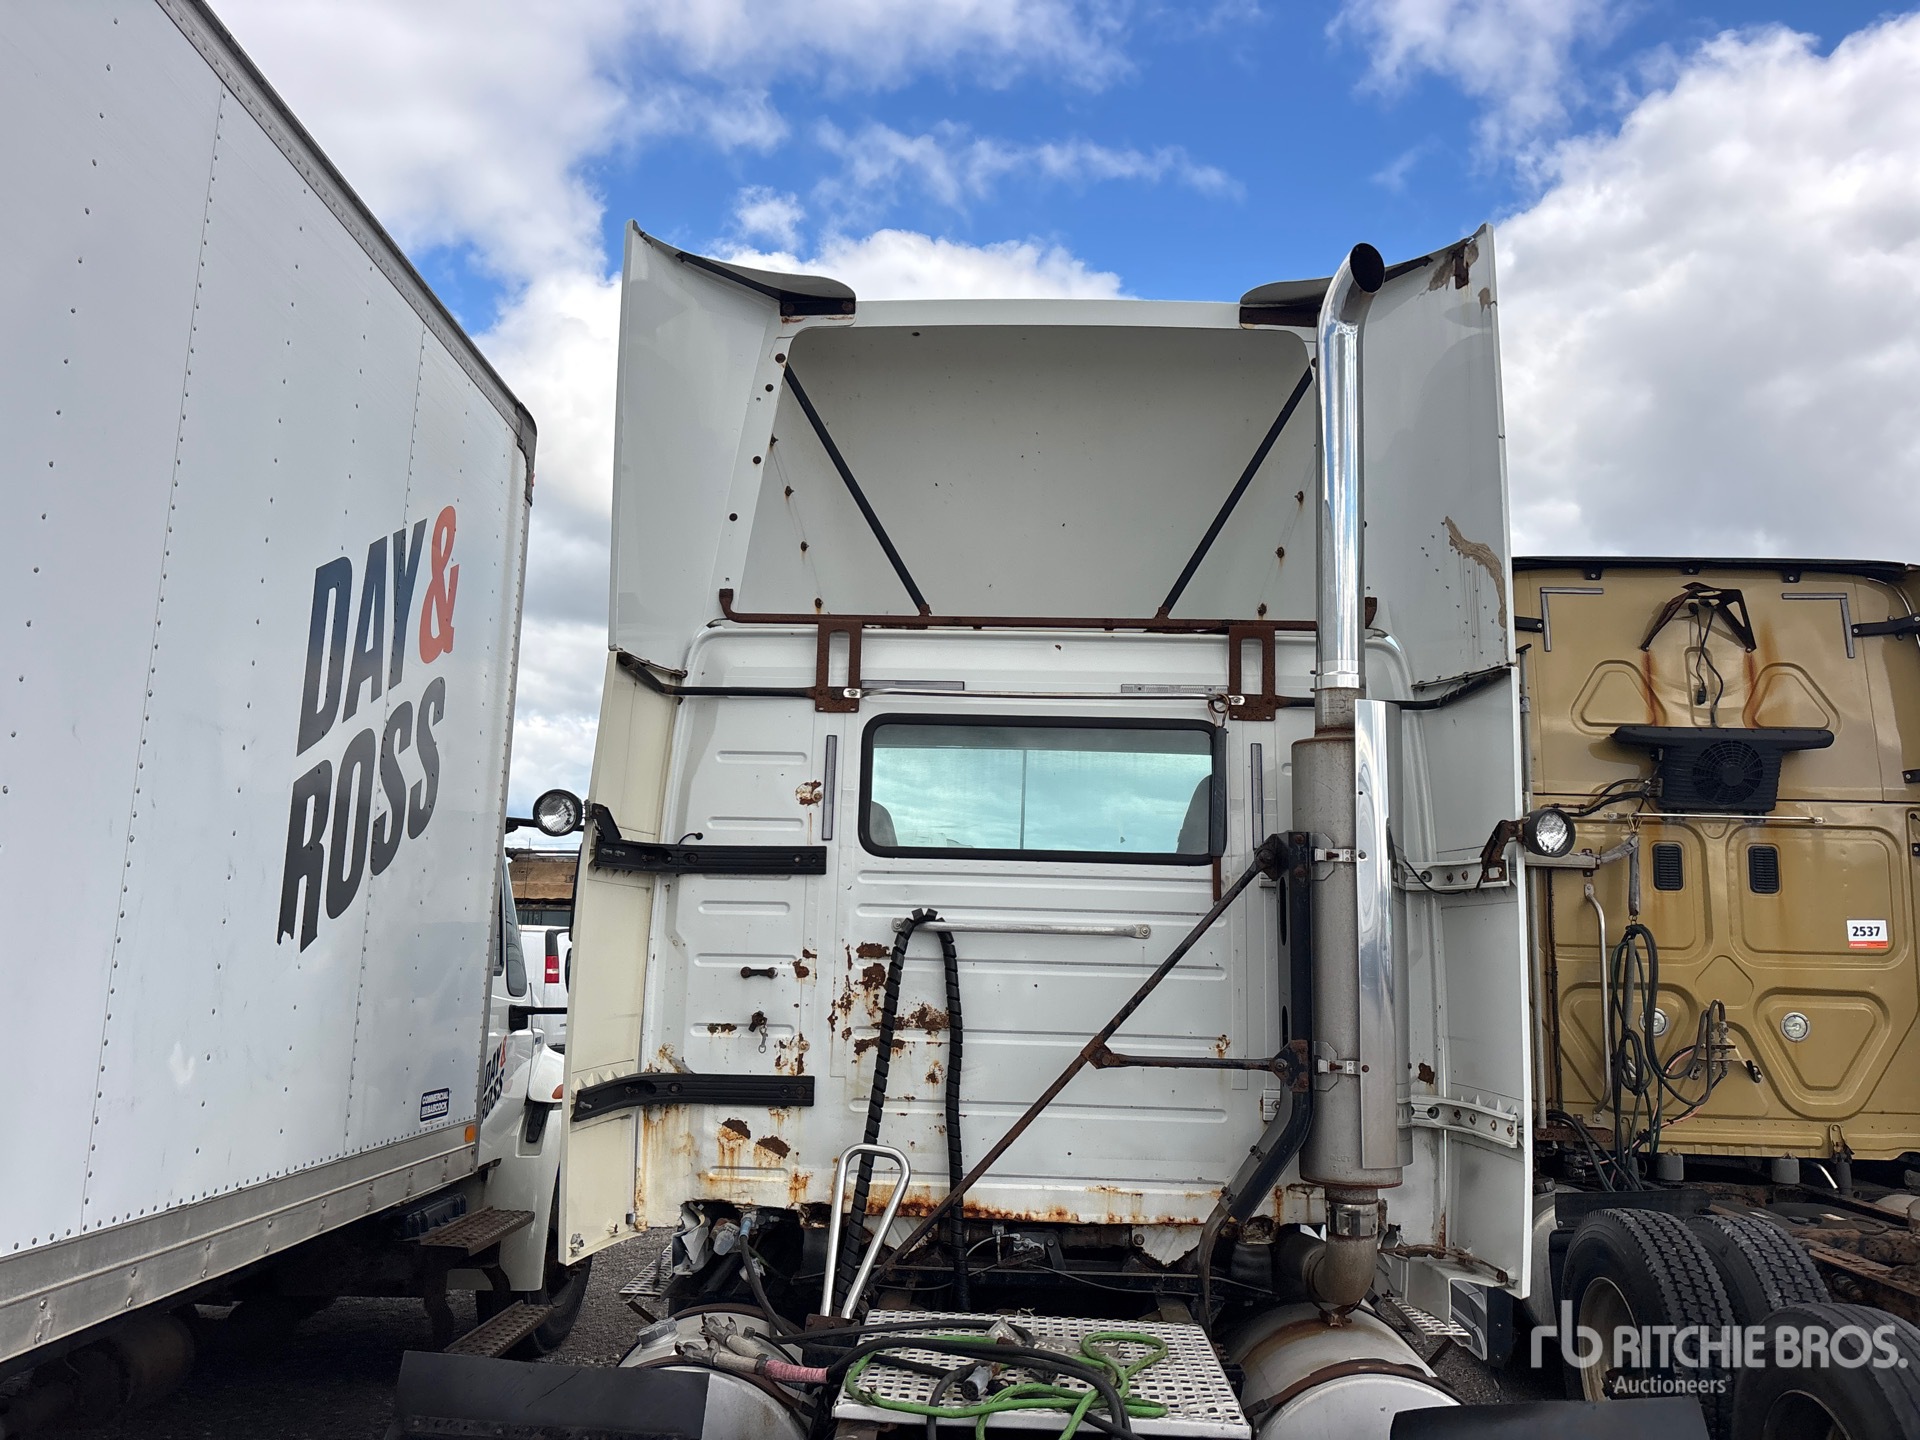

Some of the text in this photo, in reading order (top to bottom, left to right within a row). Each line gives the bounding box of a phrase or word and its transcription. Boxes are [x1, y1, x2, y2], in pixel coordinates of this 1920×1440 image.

[297, 505, 460, 757] DAY &
[277, 676, 445, 954] ROSS
[1852, 926, 1880, 937] 2537
[484, 1042, 502, 1094] DAY
